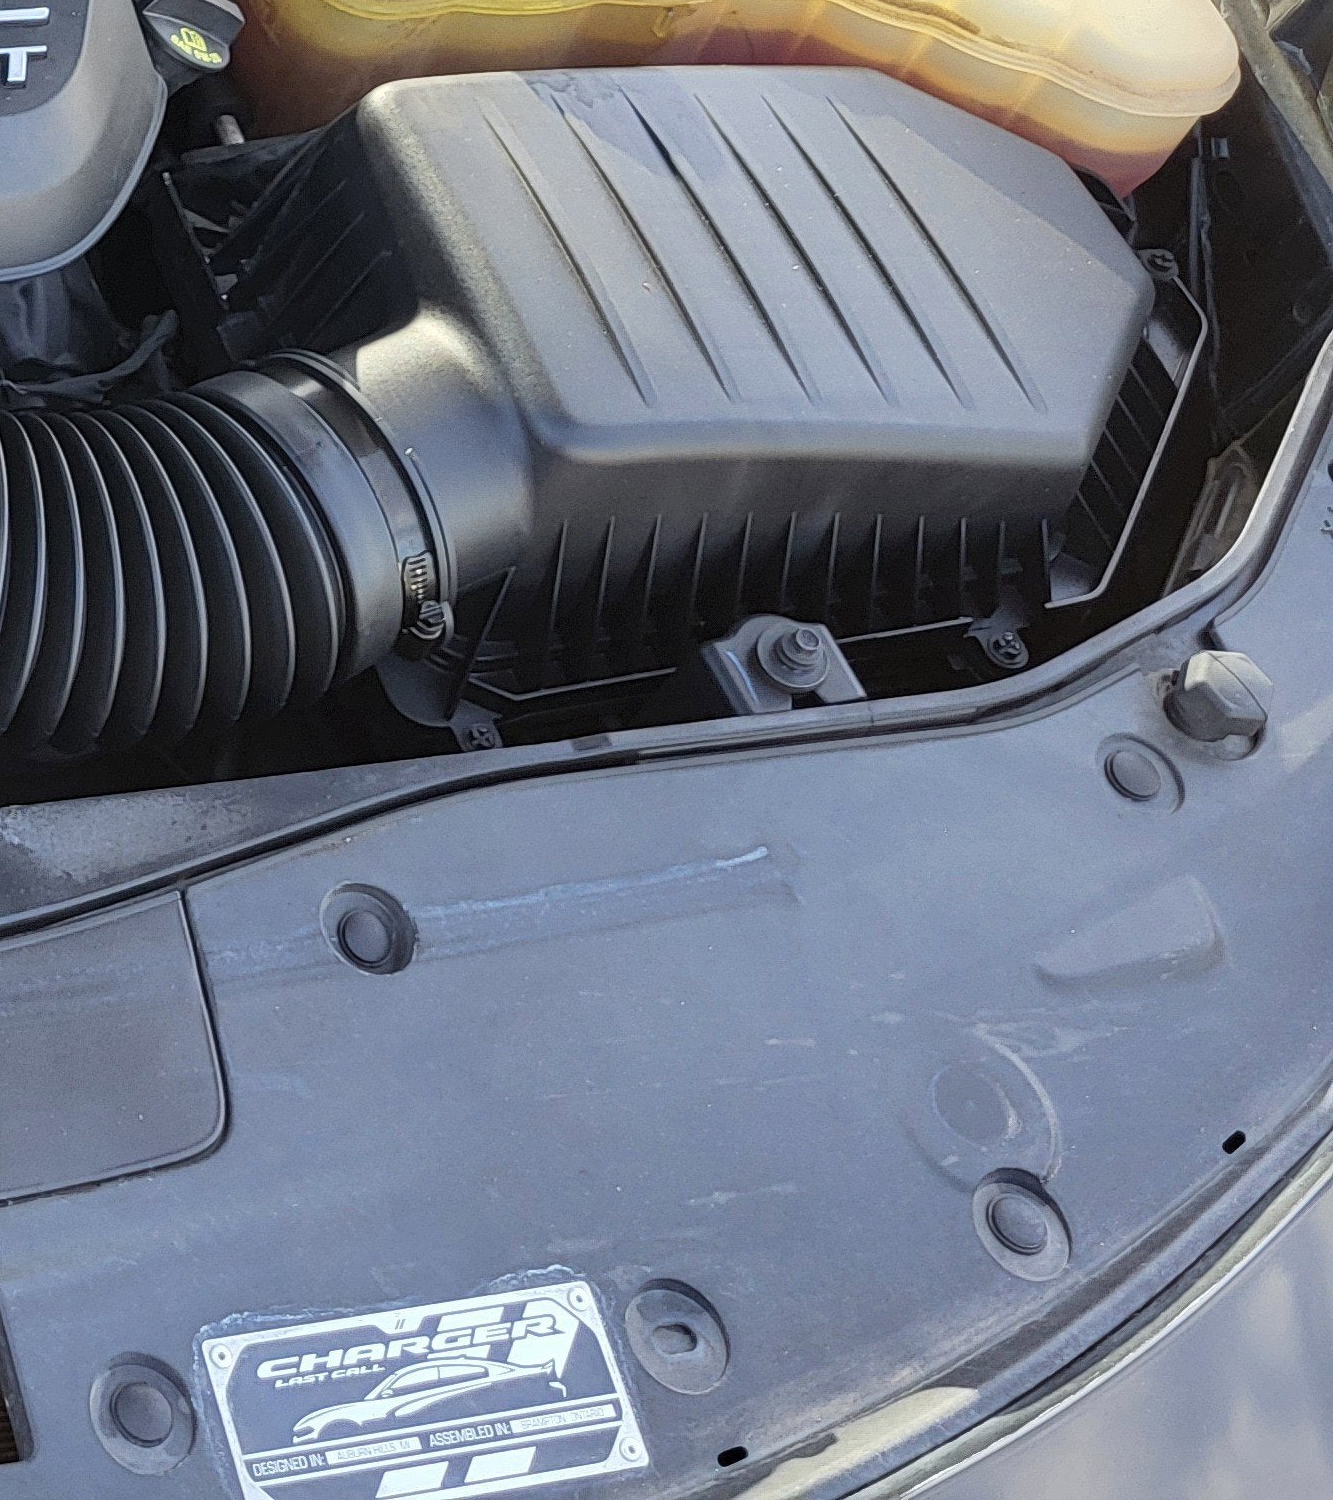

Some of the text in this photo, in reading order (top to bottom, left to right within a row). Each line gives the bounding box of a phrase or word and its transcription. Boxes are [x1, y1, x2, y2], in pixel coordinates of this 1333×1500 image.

[256, 1313, 568, 1380] CHARGER
[274, 1362, 387, 1389] LAST CALL
[429, 1424, 495, 1448] ASSEMBLED
[495, 1421, 512, 1438] IN:
[252, 1455, 308, 1478] DESIGNED
[308, 1452, 327, 1470] IN:
